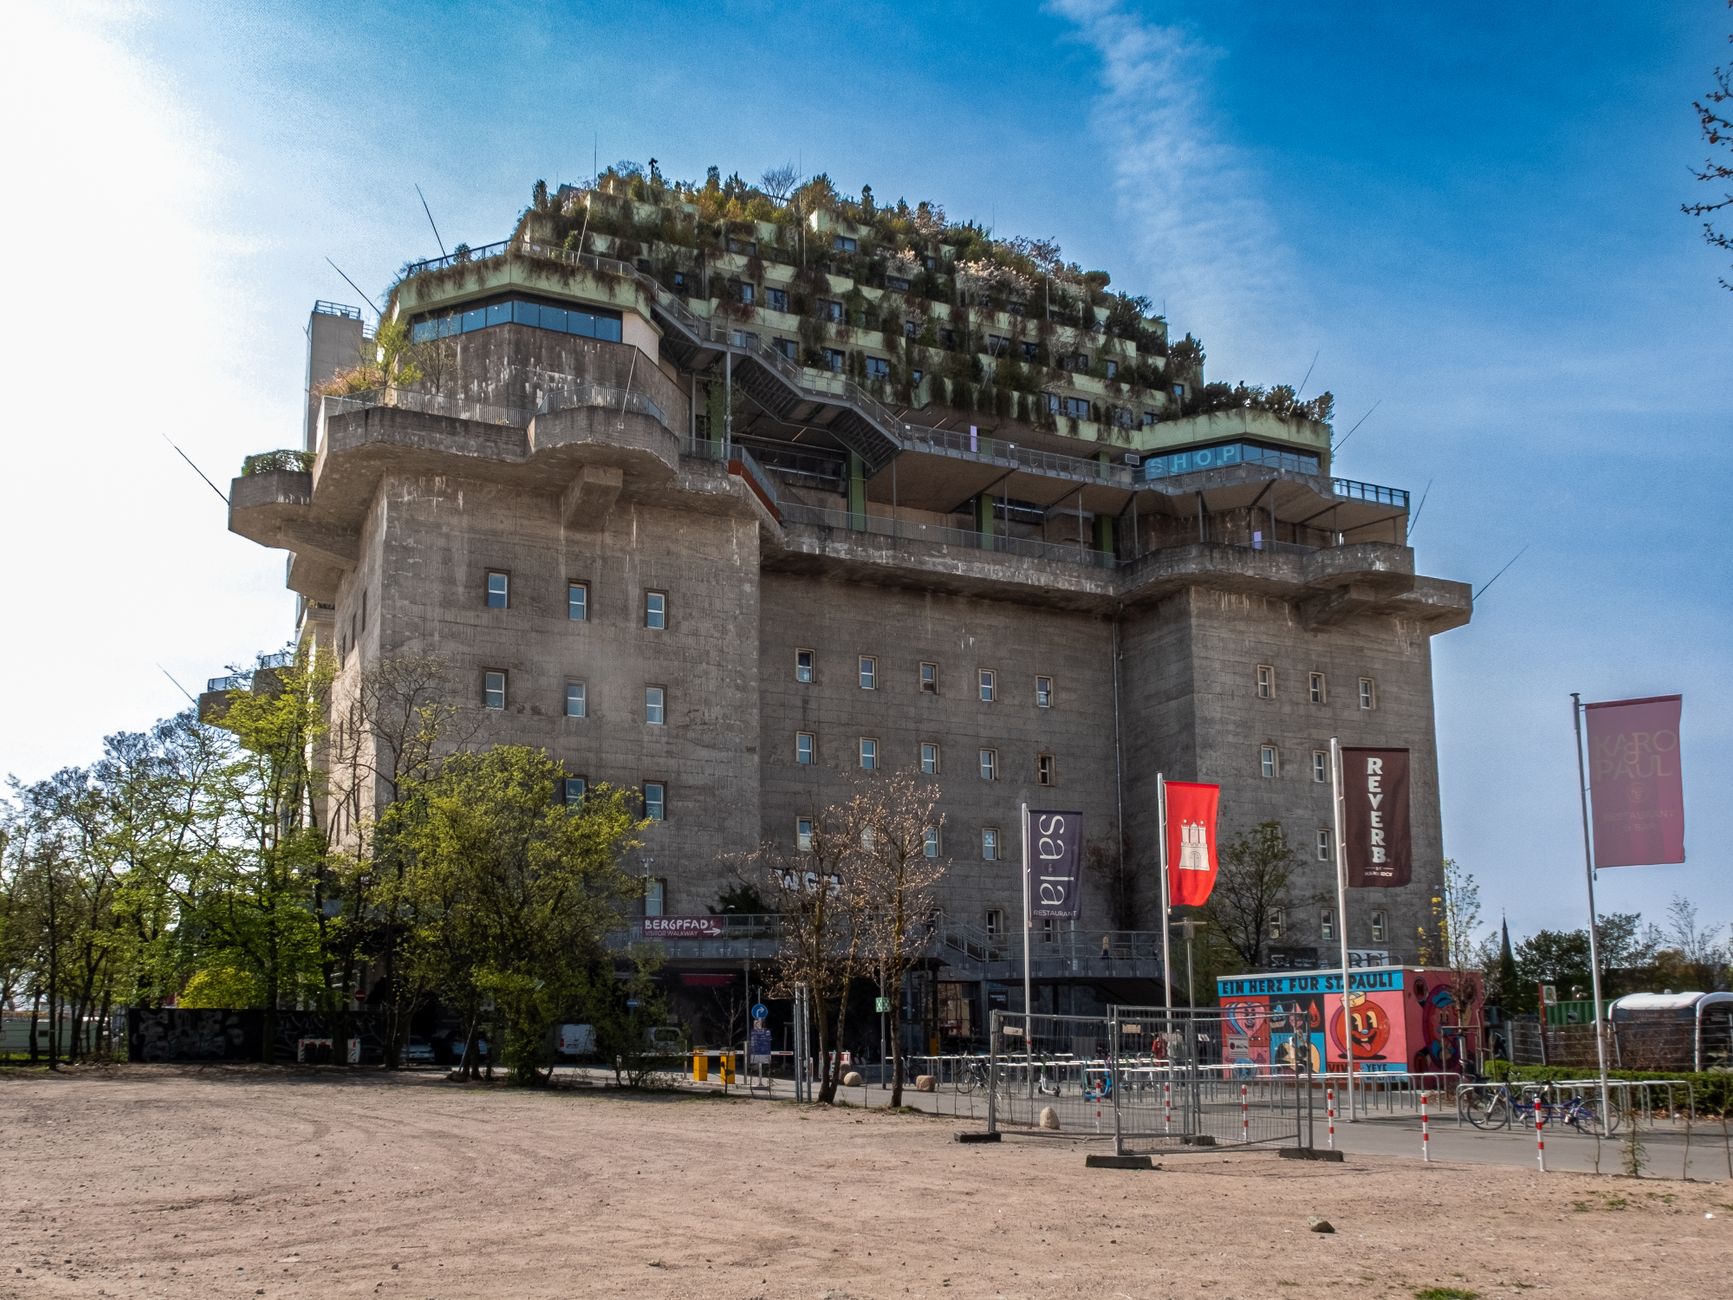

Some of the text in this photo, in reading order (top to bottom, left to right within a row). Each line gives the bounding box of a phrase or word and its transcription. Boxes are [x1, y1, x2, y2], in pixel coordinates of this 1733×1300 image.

[1150, 446, 1235, 474] SHOP
[1597, 755, 1673, 781] PAUL
[1367, 757, 1386, 863] REVERB
[644, 919, 709, 931] BERGPFAD
[1222, 981, 1245, 995] EIN
[1249, 979, 1284, 994] HERZ
